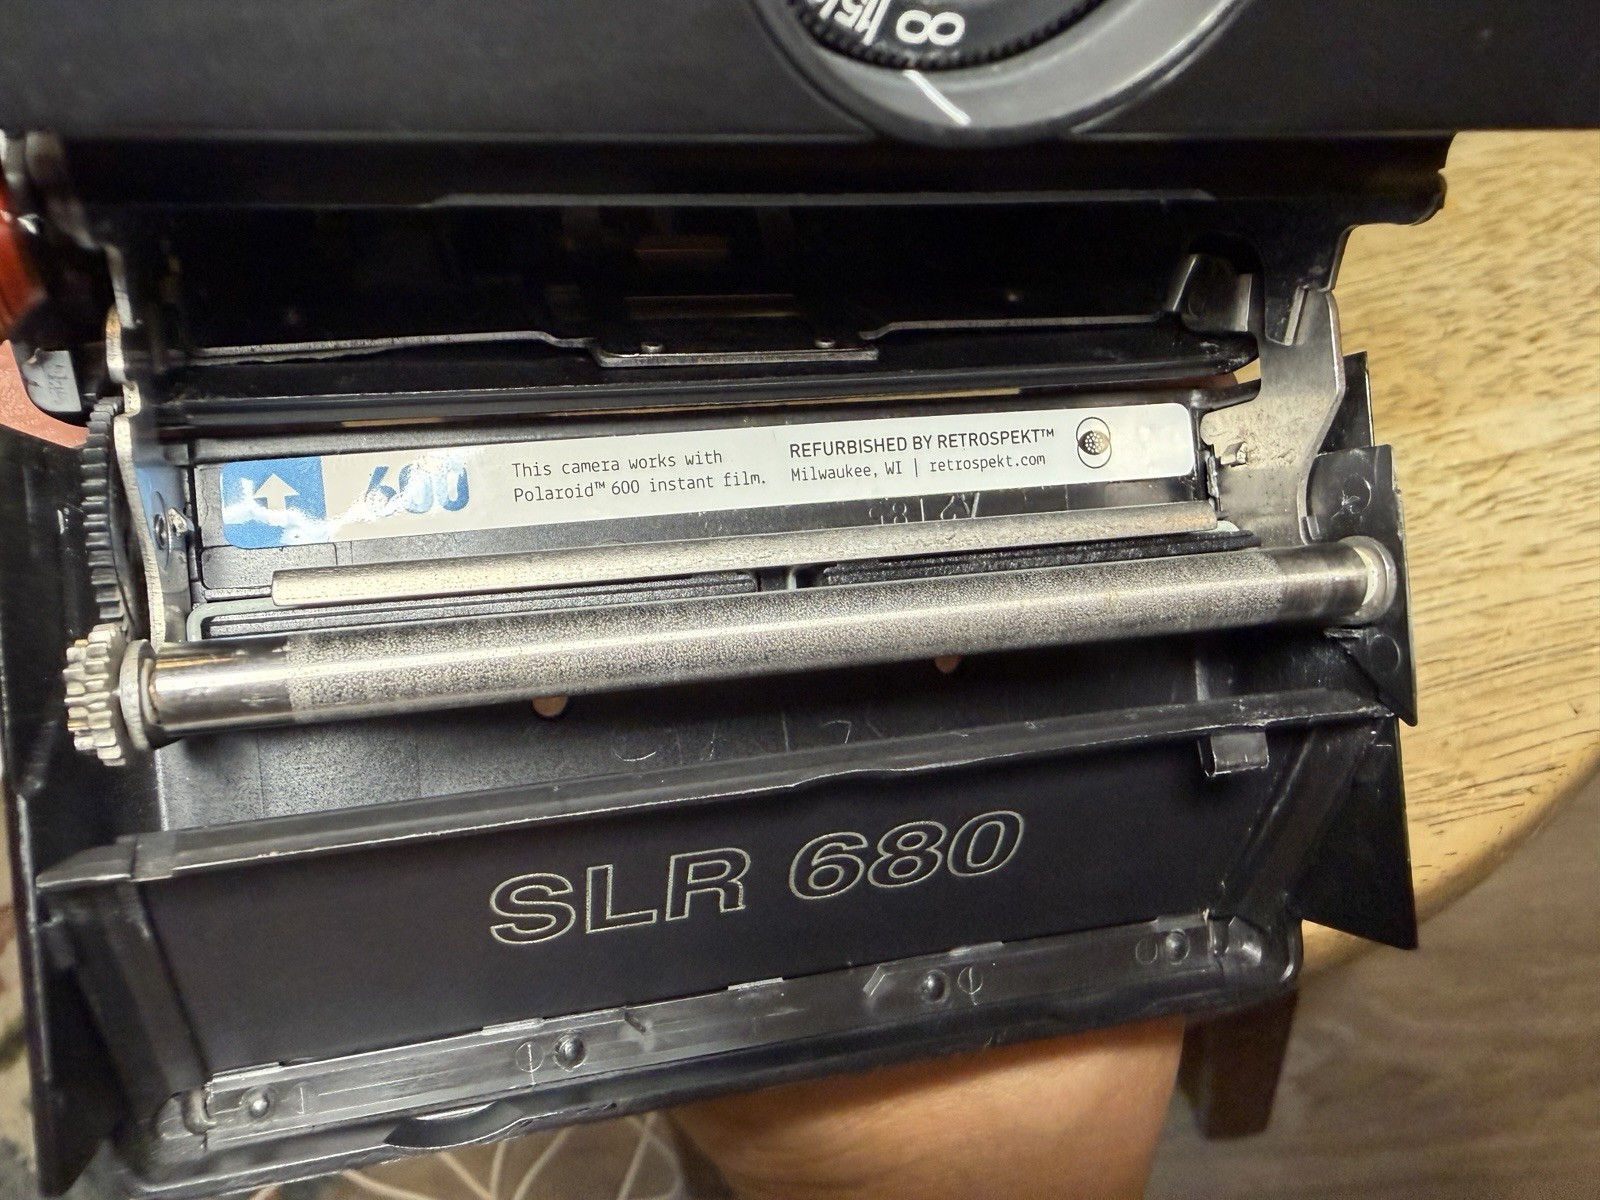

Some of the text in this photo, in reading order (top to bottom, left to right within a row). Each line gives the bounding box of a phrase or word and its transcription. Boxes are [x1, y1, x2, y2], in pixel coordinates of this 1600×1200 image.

[789, 436, 908, 459] REFURBISHED
[912, 433, 933, 450] BY
[511, 449, 723, 478] This camera works with
[790, 462, 879, 482] Milwaukee,
[884, 460, 903, 476] WI
[929, 453, 1046, 474] retrospekt.com
[611, 479, 640, 496] 600
[649, 472, 715, 493] instant
[723, 470, 767, 488] film.
[489, 810, 1025, 945] SLR 680
